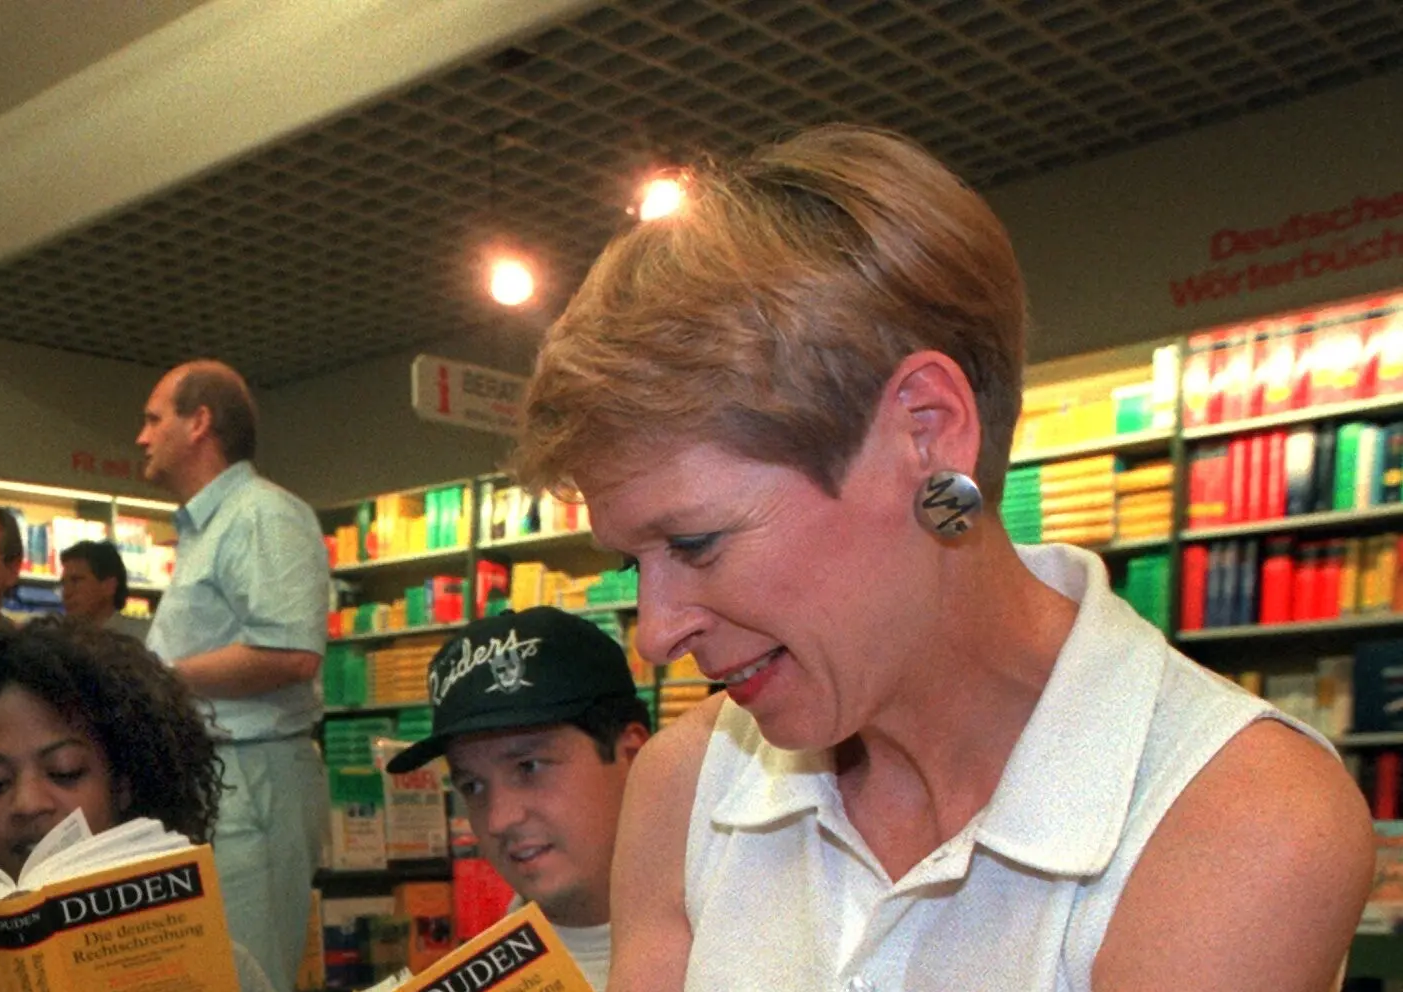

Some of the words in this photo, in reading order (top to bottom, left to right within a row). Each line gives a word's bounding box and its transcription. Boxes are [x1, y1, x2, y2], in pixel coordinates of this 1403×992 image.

[60, 869, 195, 924] DUDEN
[73, 923, 205, 964] Rechtschreibung
[84, 931, 114, 946] Die
[118, 912, 188, 936] deutsche
